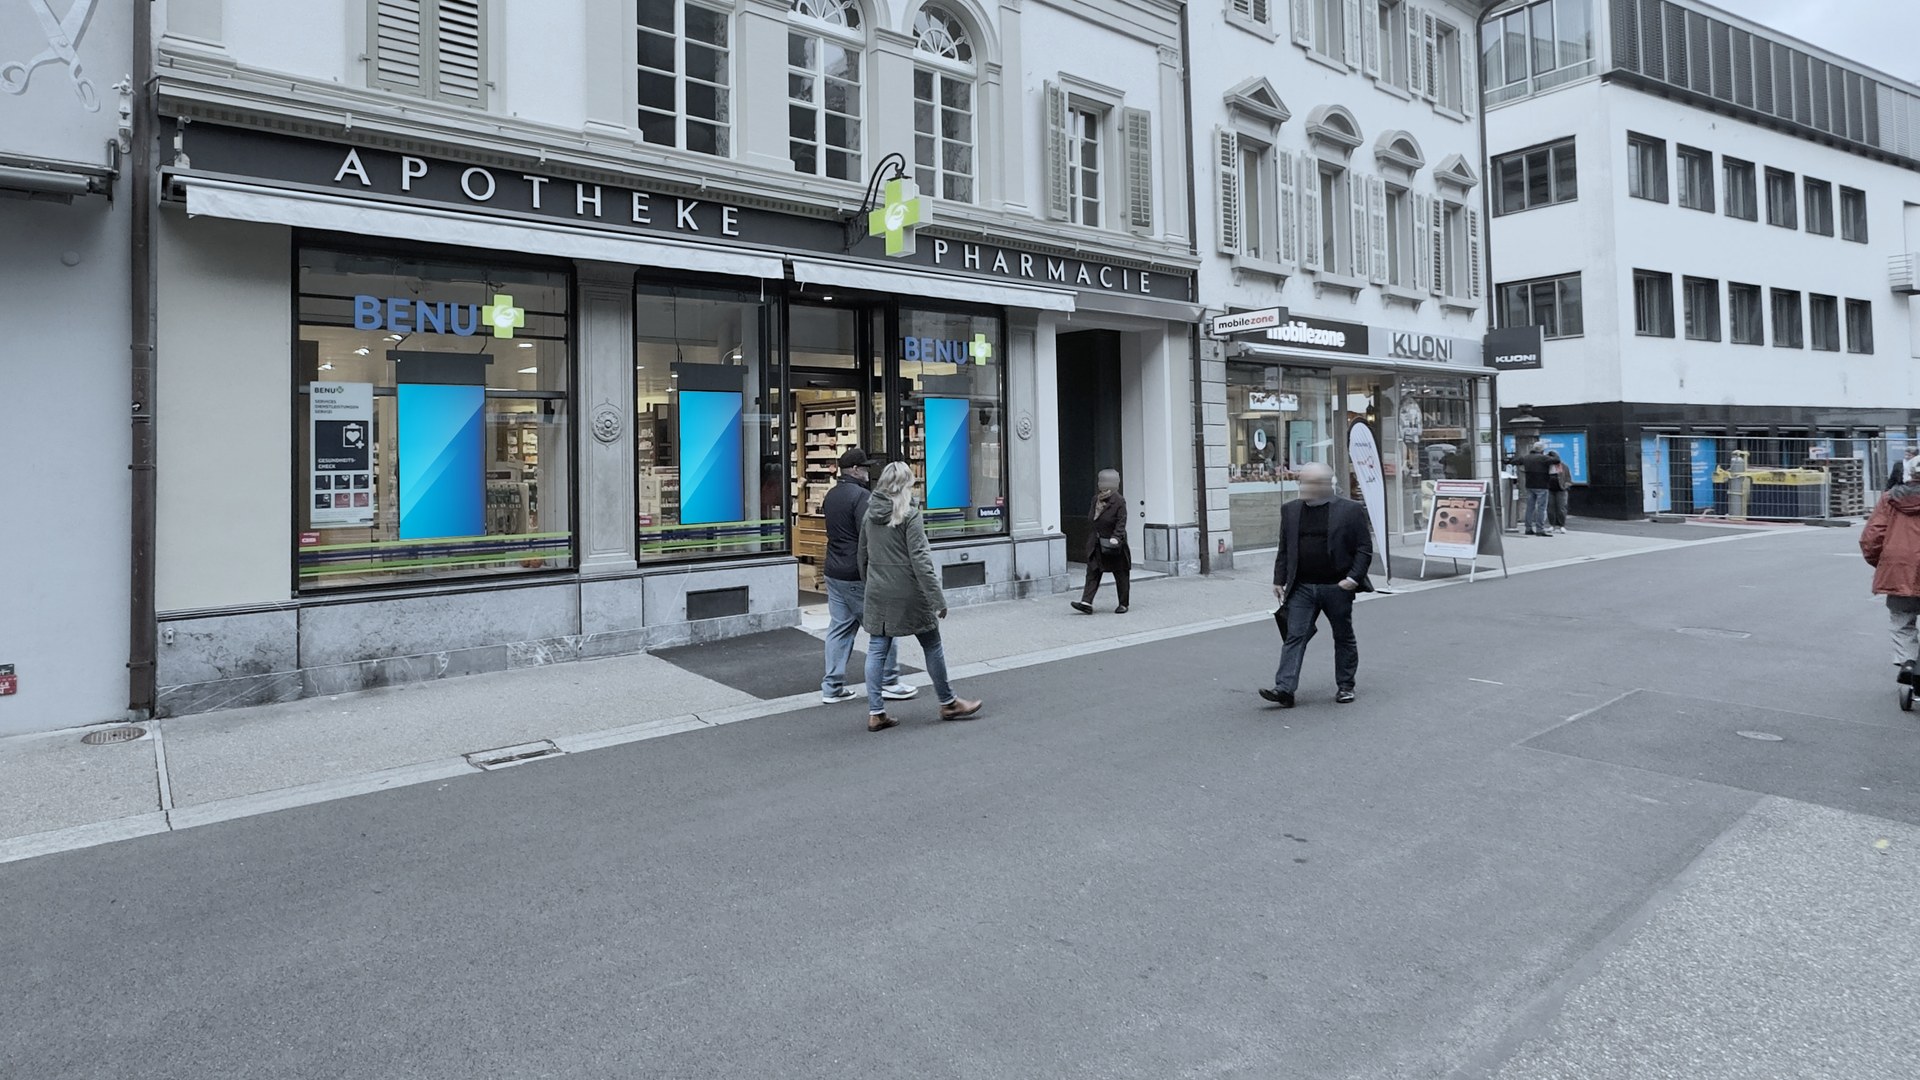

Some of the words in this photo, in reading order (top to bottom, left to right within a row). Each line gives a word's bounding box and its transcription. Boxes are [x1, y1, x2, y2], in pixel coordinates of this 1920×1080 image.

[333, 147, 740, 237] APOTHEKE
[933, 239, 1150, 293] PHARMACIE
[354, 295, 478, 336] BENU
[1218, 315, 1274, 329] mobilezone
[1266, 320, 1345, 347] mobilezone
[1392, 332, 1453, 360] KUONI
[904, 336, 968, 365] BENU
[1495, 354, 1537, 363] KUONI
